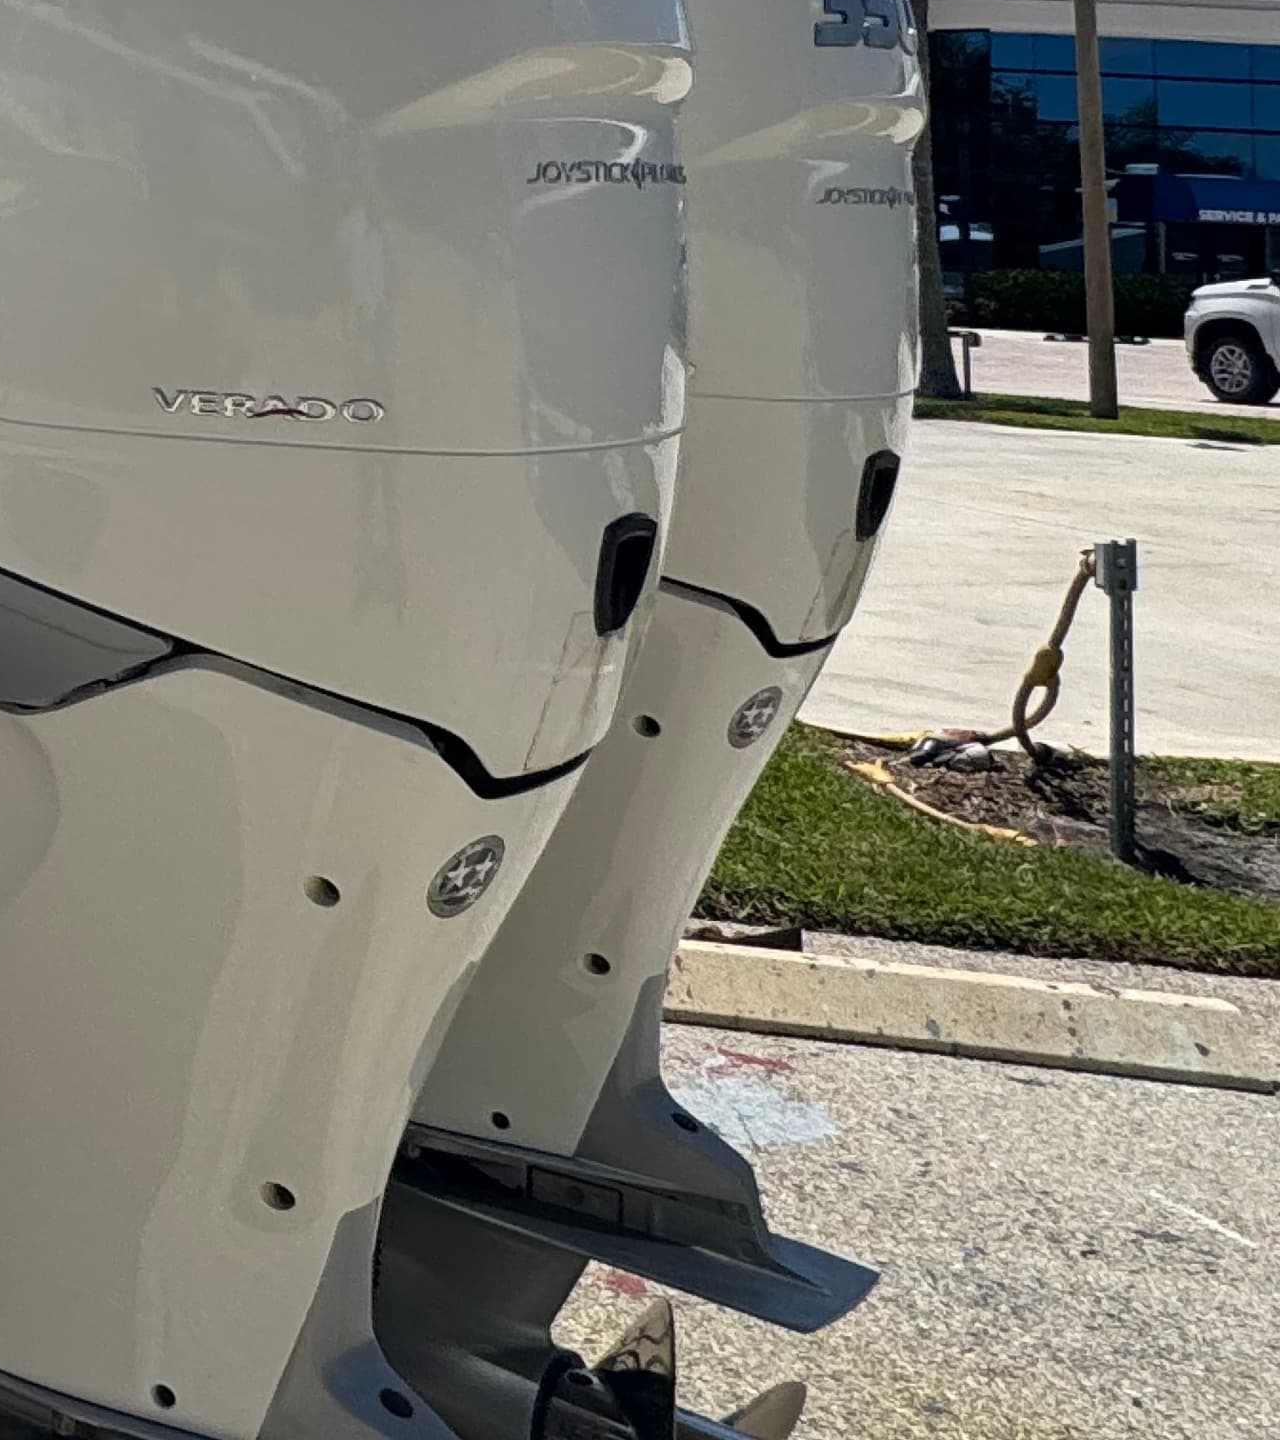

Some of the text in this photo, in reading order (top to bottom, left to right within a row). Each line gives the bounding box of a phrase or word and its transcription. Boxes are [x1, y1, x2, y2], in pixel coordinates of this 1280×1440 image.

[526, 160, 630, 185] JOYSTICK
[1198, 210, 1253, 223] SERVICE
[151, 386, 385, 423] VERADO
